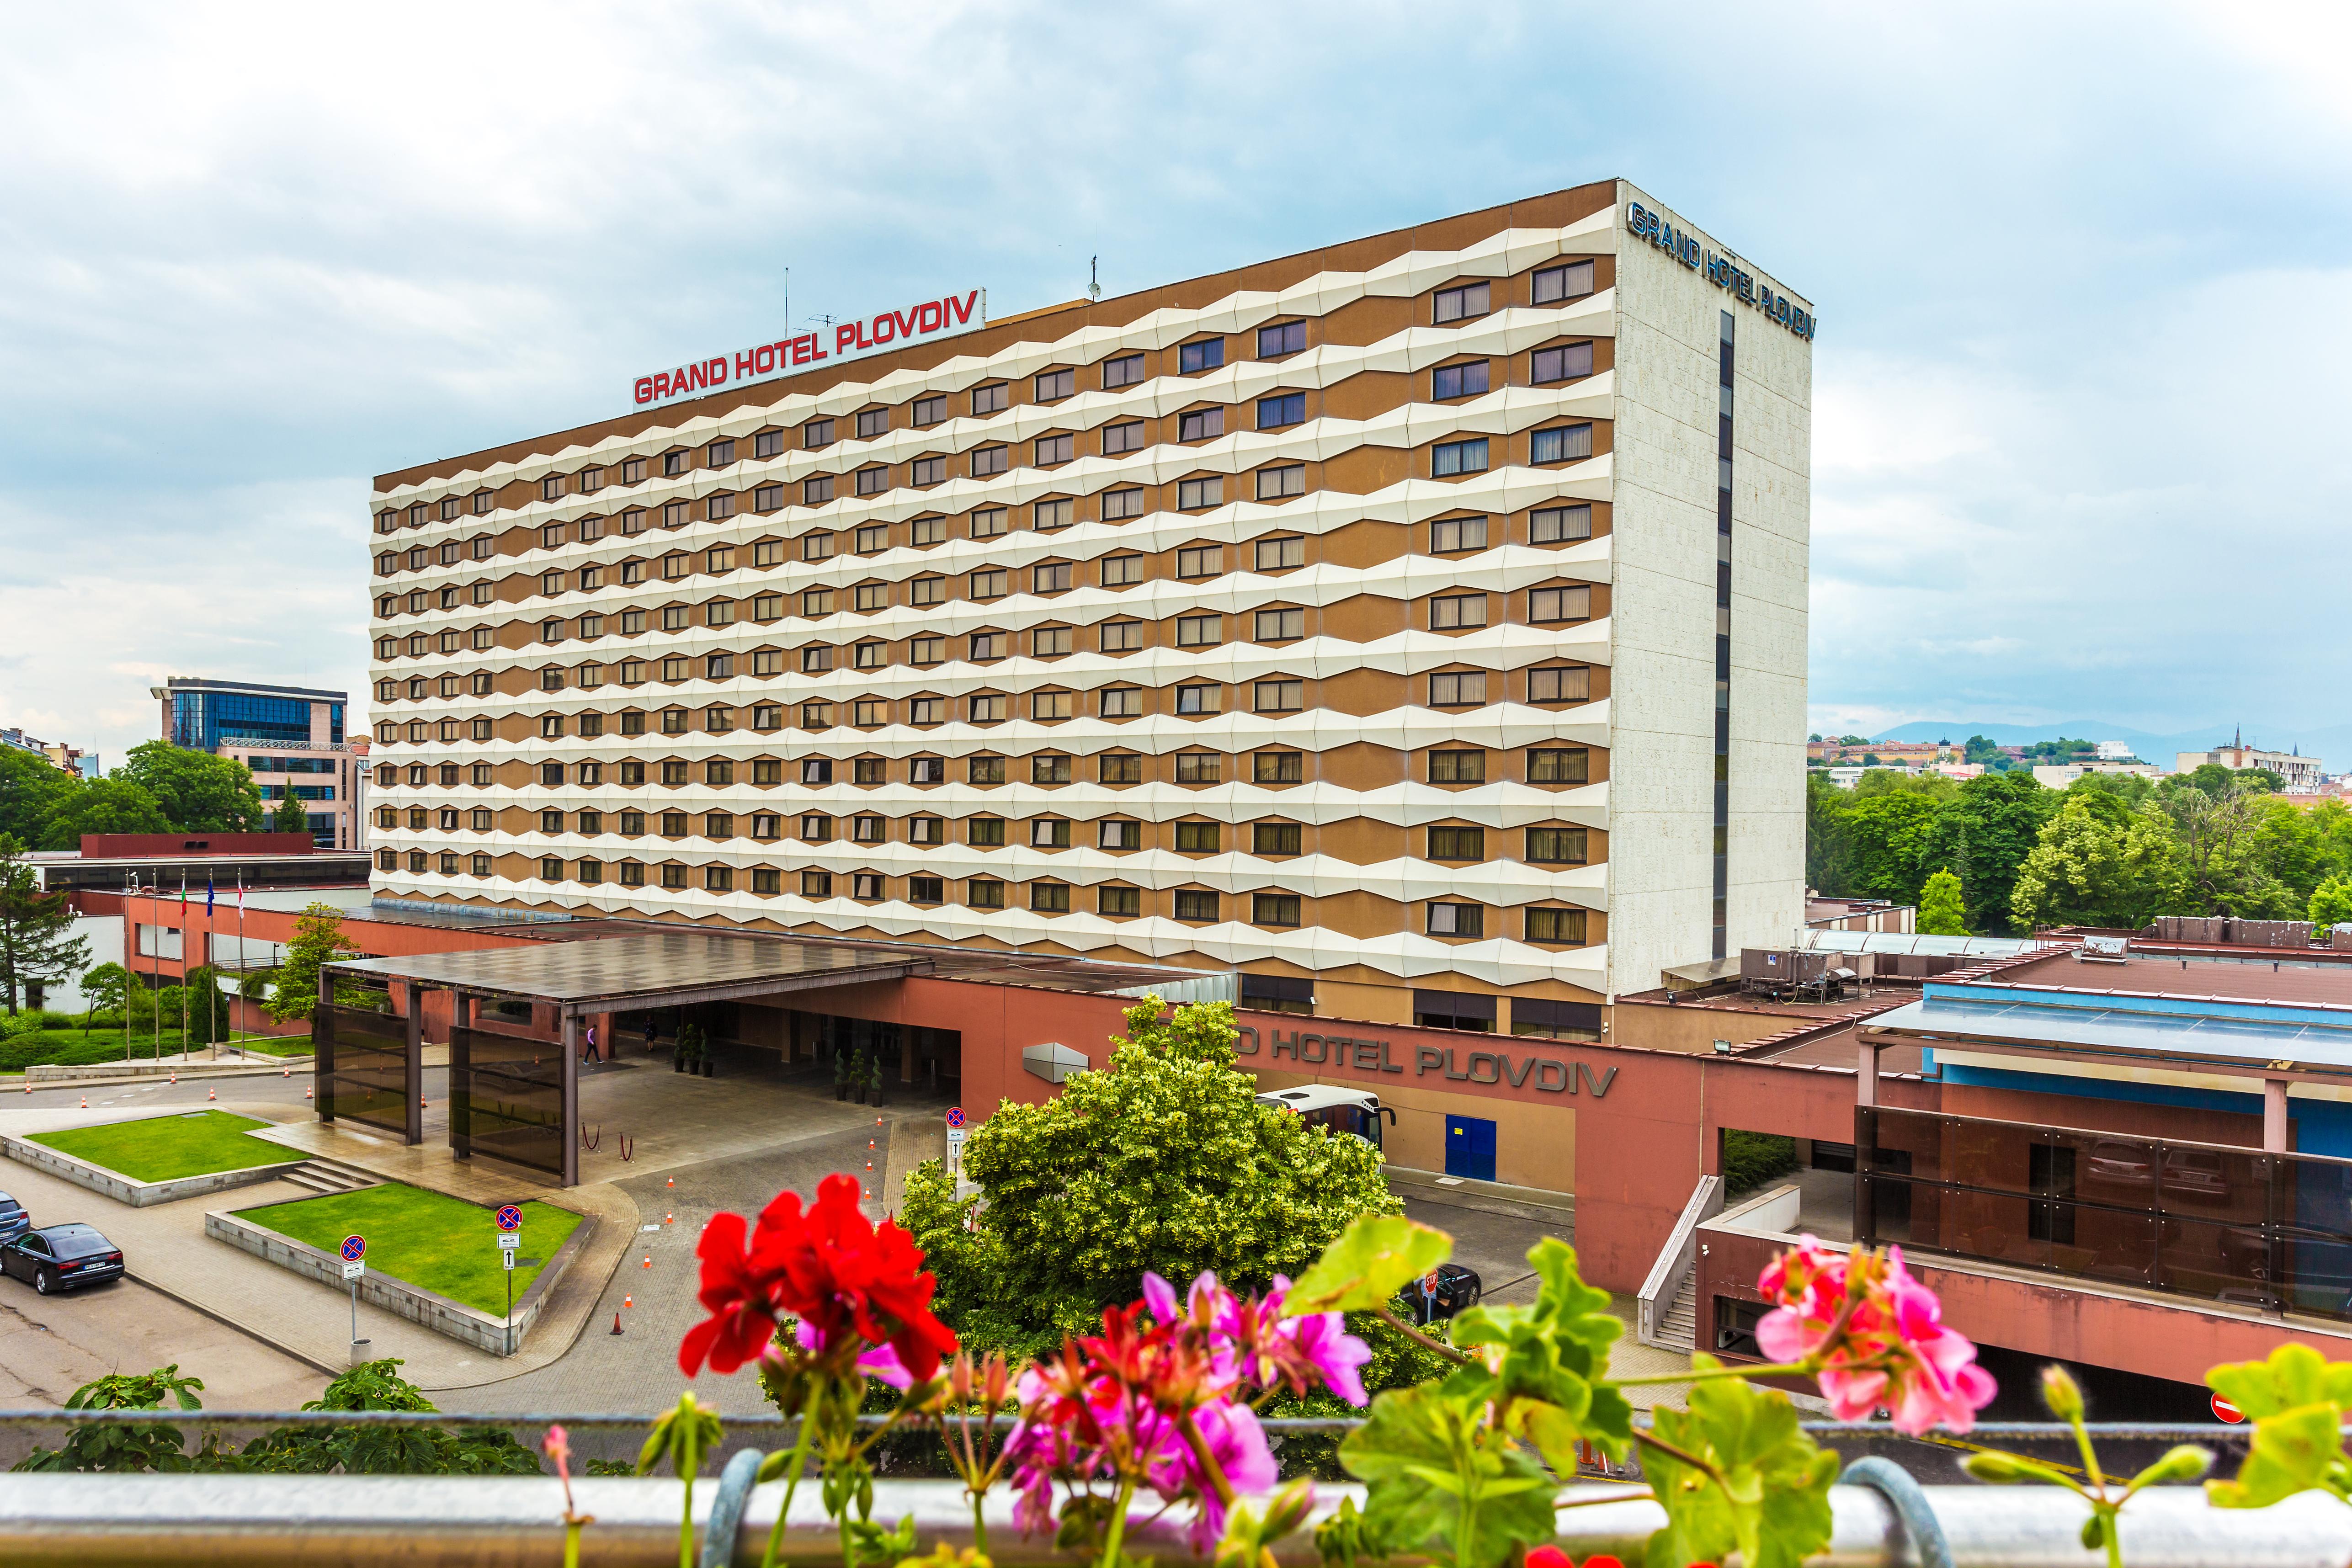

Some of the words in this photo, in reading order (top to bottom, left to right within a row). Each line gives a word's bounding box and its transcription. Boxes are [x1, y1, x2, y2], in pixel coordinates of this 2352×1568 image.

[1628, 201, 1701, 269] GRAND
[1703, 248, 1756, 305] HOTEL
[1757, 283, 1817, 341] PLOVDIV
[635, 357, 727, 404] GRAND
[735, 332, 828, 380] HOTEL
[836, 289, 978, 355] PLOVDIV
[1272, 1029, 1403, 1073] HOTEL
[1416, 1045, 1619, 1097] PLOVDIV
[1426, 1274, 1437, 1286] STOP
